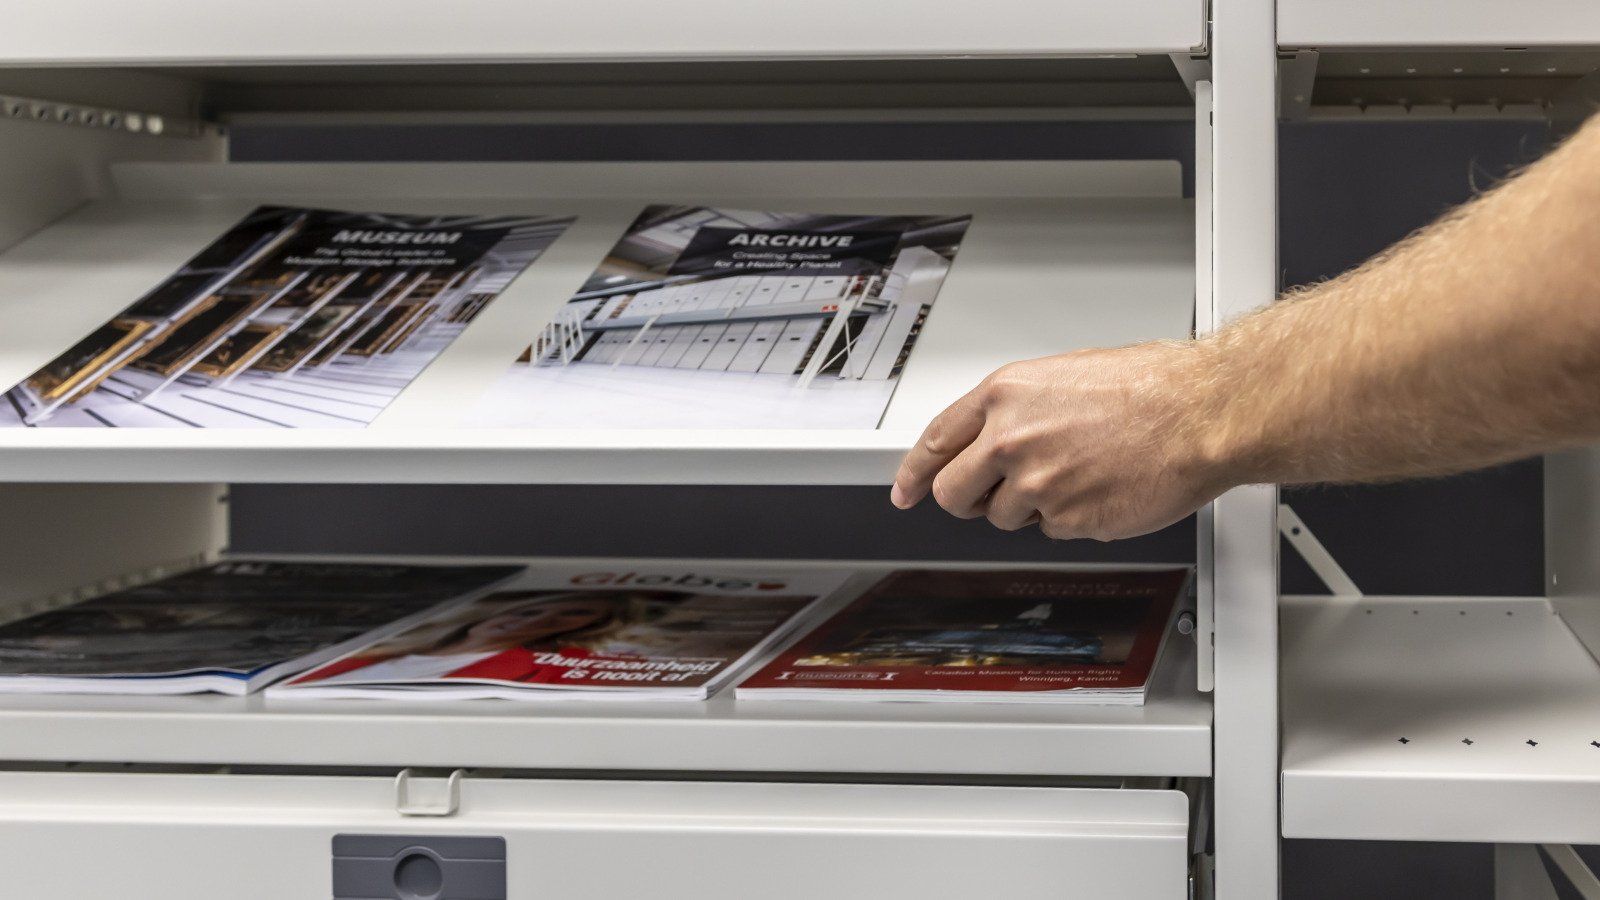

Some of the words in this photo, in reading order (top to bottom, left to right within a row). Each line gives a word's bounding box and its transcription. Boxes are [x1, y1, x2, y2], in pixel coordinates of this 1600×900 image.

[332, 230, 462, 243] MUSEUM
[728, 233, 853, 247] ARCHIVE
[732, 251, 788, 261] Creating
[790, 252, 832, 261] Space
[714, 260, 732, 268] for
[747, 261, 797, 270] Healthy
[800, 262, 842, 270] Planet
[591, 670, 659, 681] nooit
